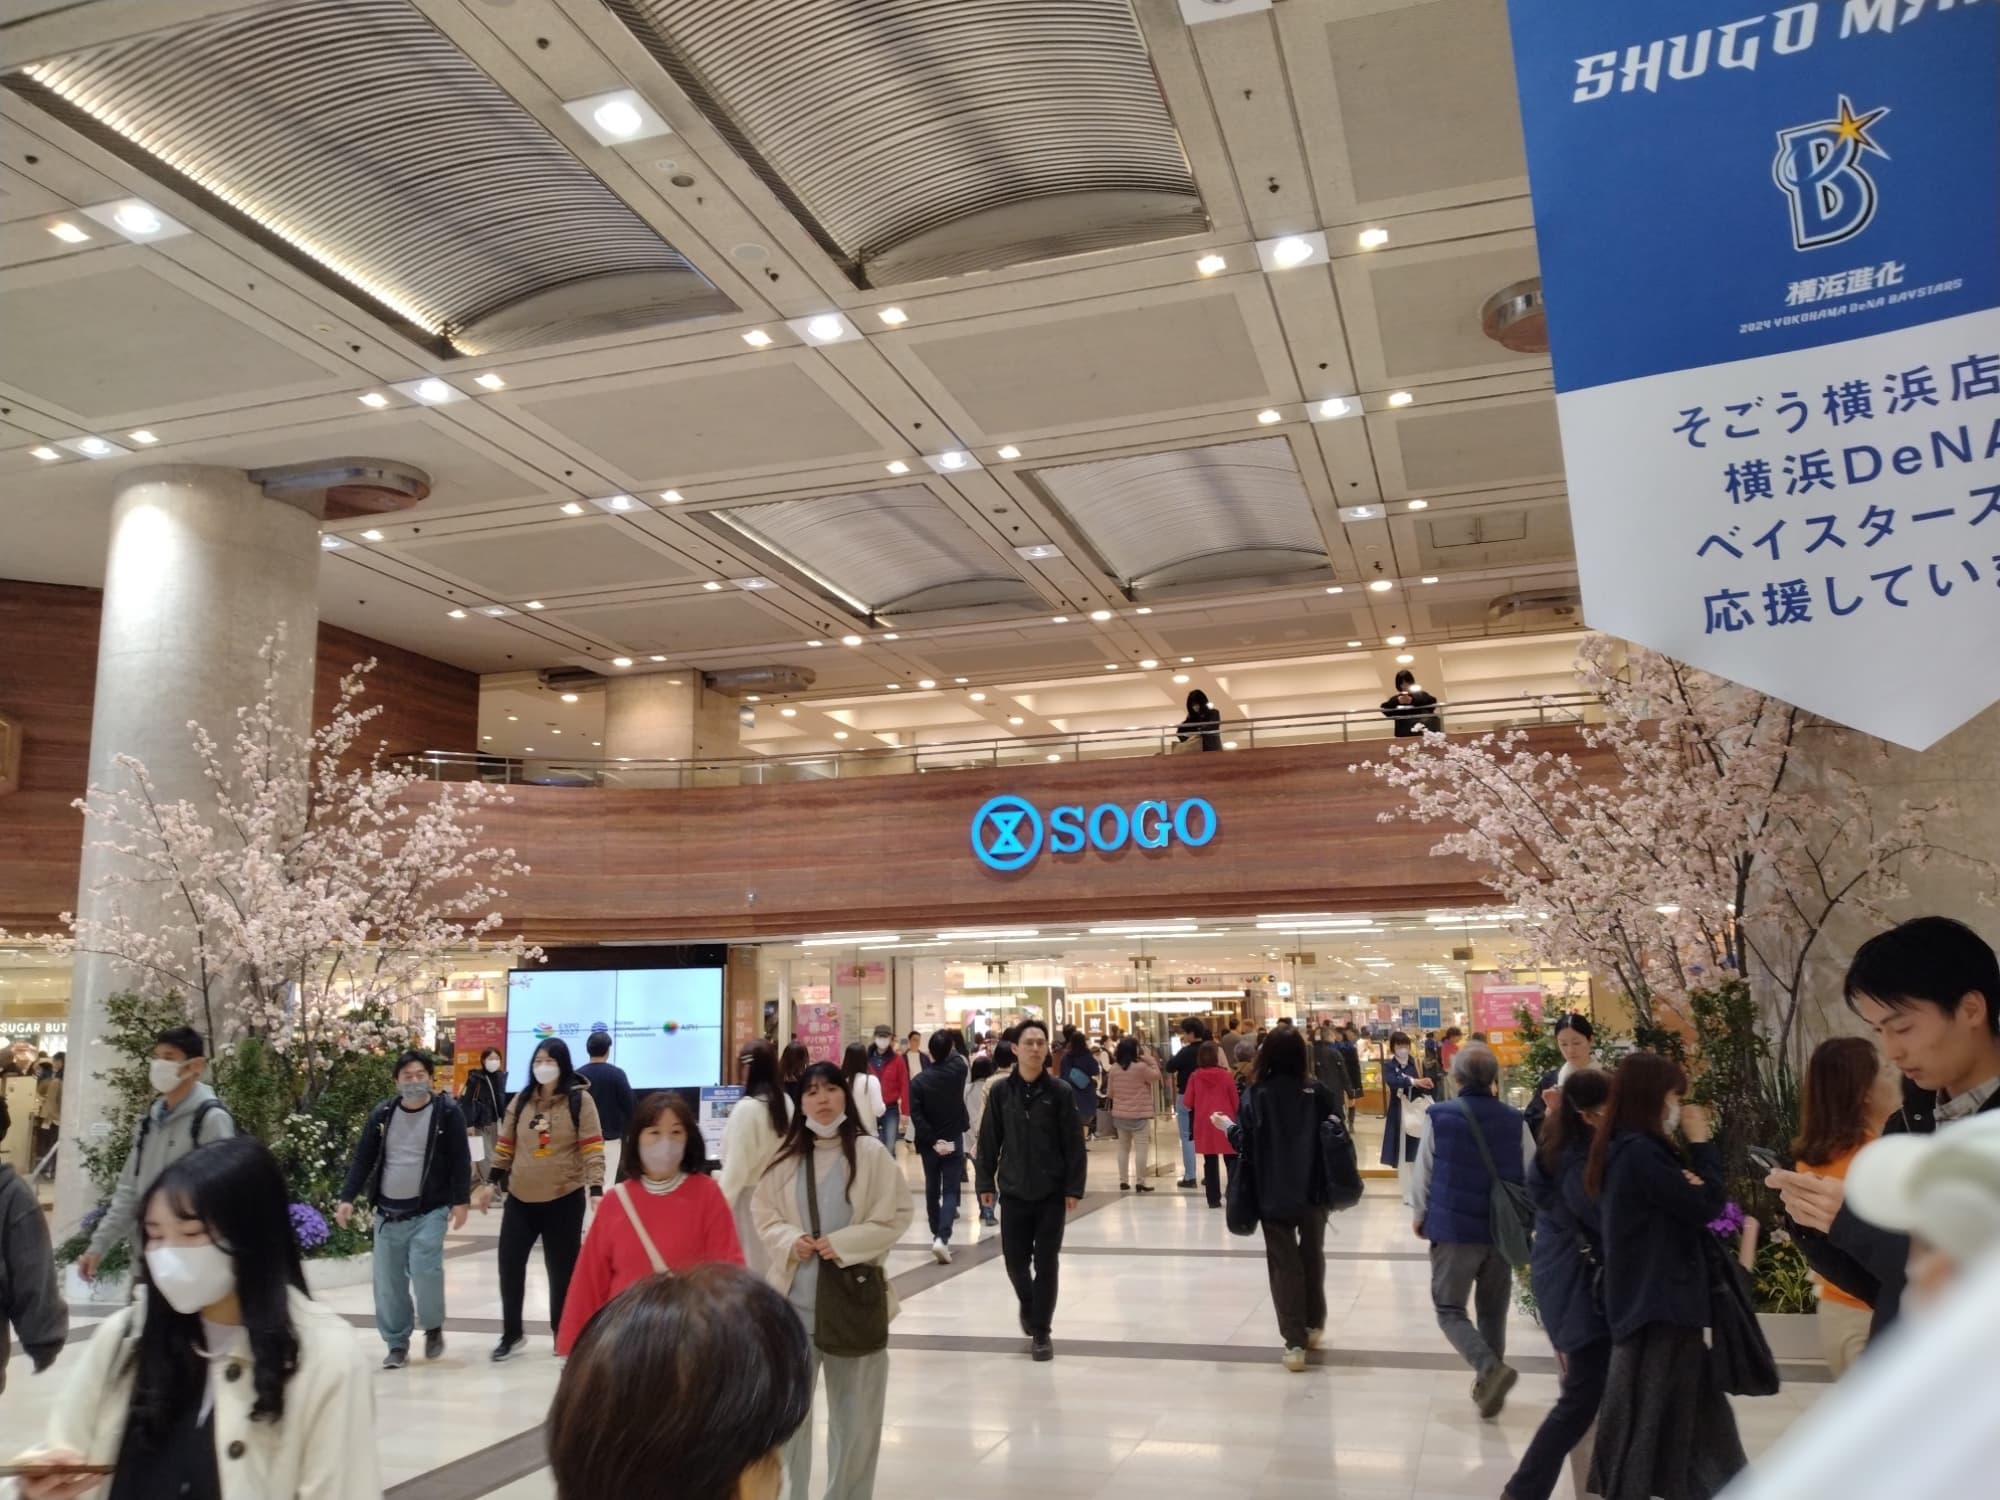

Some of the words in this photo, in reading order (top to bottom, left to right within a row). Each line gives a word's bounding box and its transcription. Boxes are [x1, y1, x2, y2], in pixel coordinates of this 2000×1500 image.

[1573, 2, 1817, 103] SHUGO
[1739, 320, 1771, 334] 2024
[1773, 304, 1847, 328] YOKOHAMA
[1849, 297, 1885, 313] DeNA
[1888, 278, 1963, 305] BAYSTARS
[1784, 260, 1906, 307] 横浜進化
[1672, 353, 2000, 448] そごう横浜店
[1704, 553, 2000, 634] 応援してい
[1050, 797, 1217, 853] SOGO
[0, 1022, 40, 1033] SUGAR
